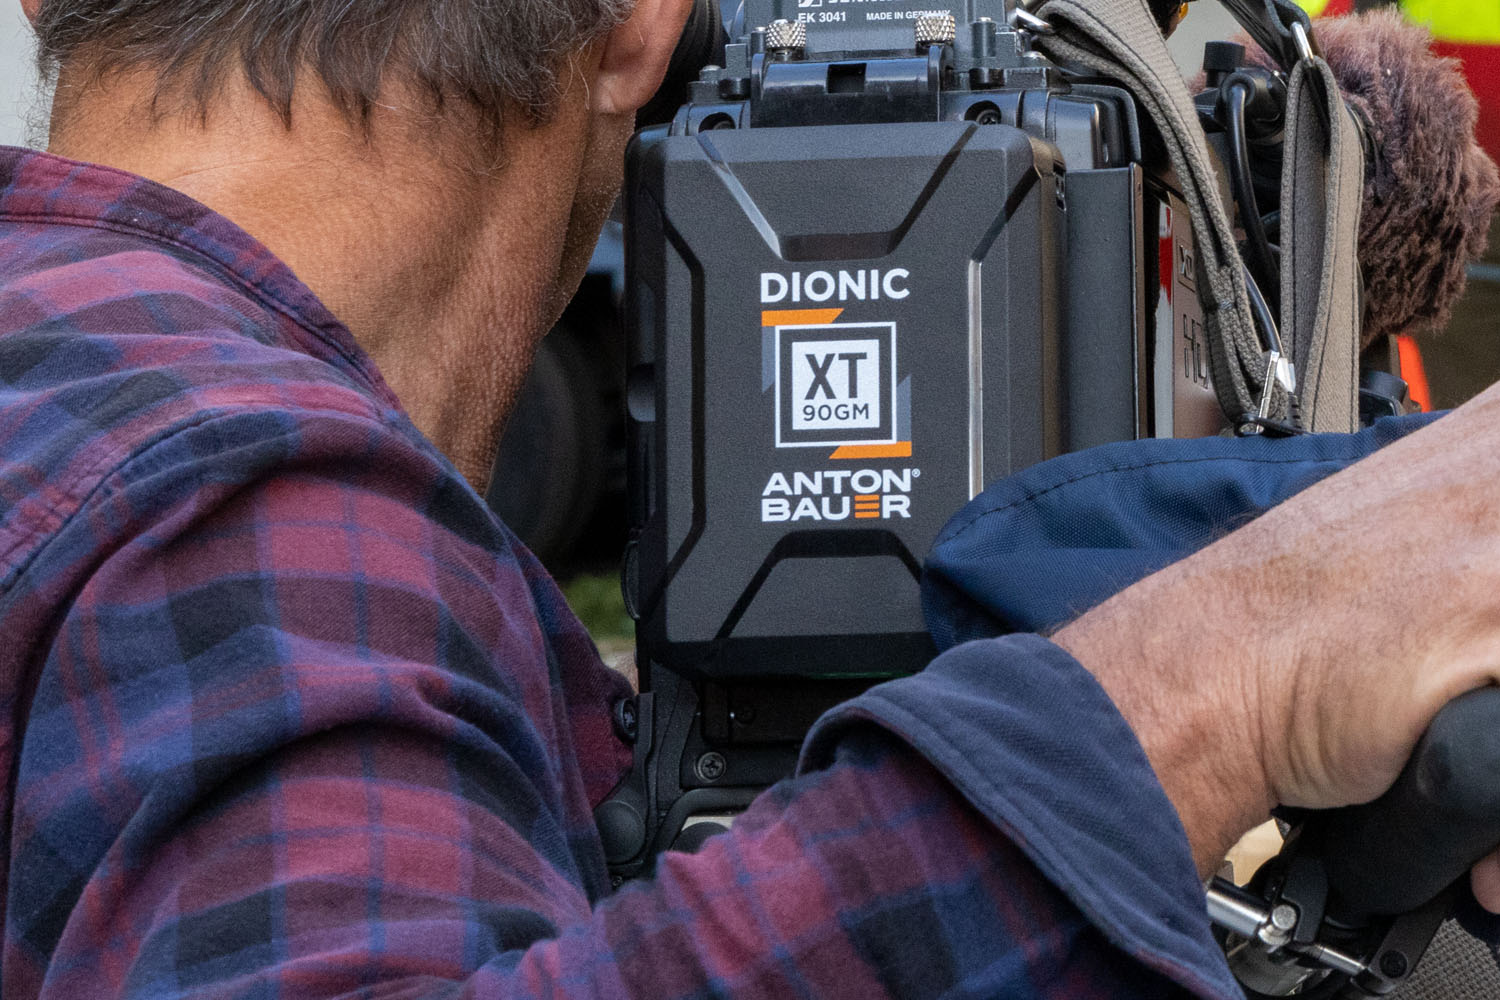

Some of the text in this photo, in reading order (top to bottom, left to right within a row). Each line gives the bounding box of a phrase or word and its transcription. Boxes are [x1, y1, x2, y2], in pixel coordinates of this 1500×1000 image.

[798, 12, 816, 23] EK
[819, 11, 846, 22] 3041
[866, 11, 892, 20] MADE
[894, 11, 904, 19] IN
[760, 268, 910, 303] DIONIC
[804, 352, 868, 400] XT
[803, 403, 870, 421] 90GM
[761, 494, 911, 522] BAUER
